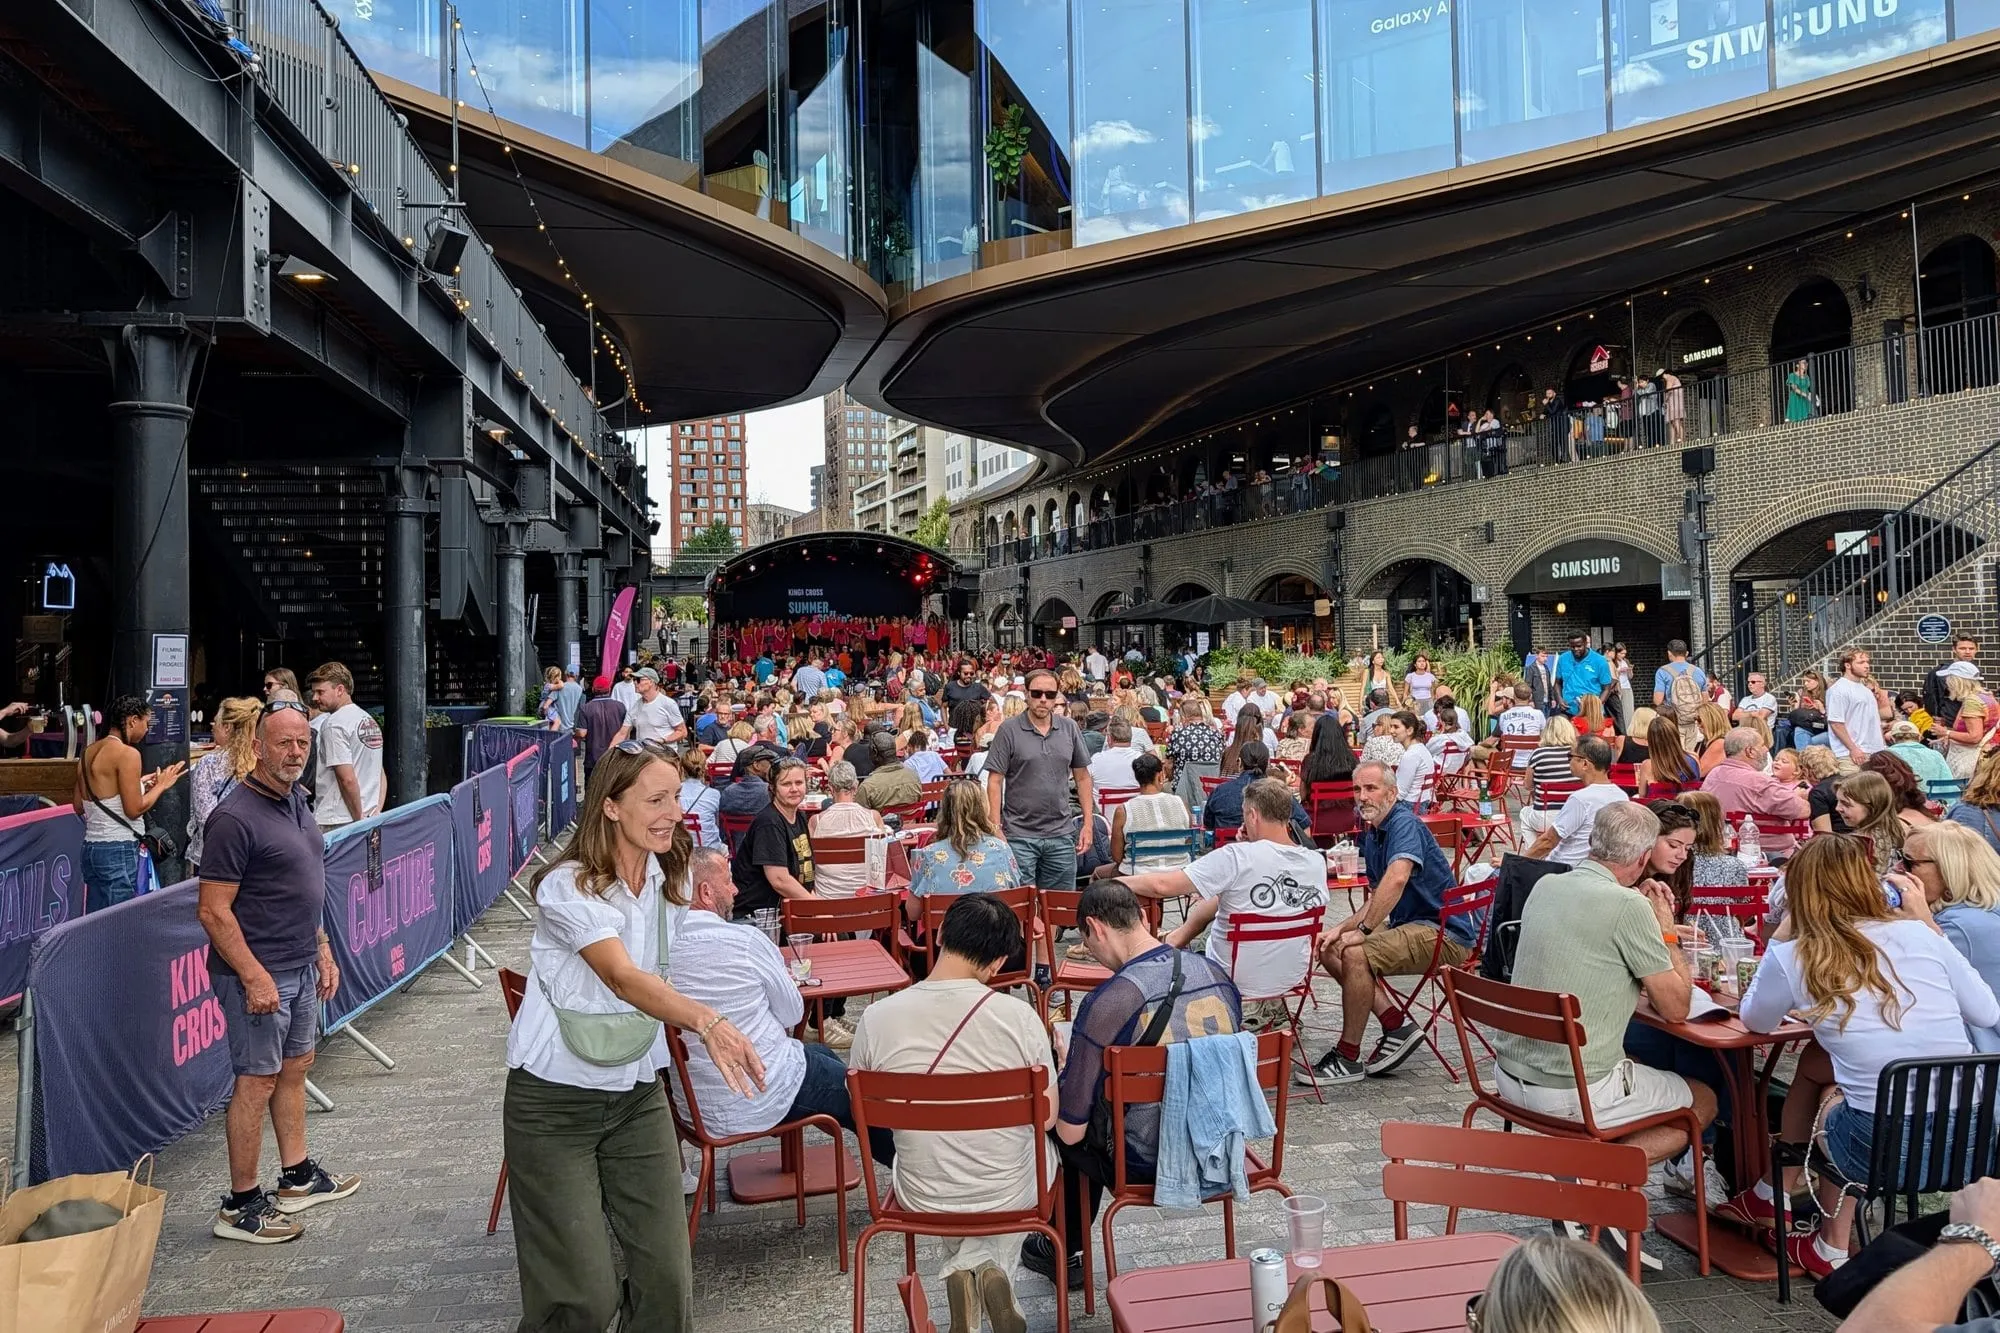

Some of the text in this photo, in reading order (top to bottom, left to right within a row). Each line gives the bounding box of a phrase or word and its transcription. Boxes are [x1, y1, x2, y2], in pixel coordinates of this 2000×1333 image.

[1371, 7, 1432, 33] Galaxy
[1687, 0, 1898, 70] SAMSUNG
[1684, 346, 1724, 363] SAMSUNG
[1551, 557, 1620, 578] SAMSUNG
[805, 588, 823, 596] CROSS
[788, 601, 829, 614] SUMMER
[0, 854, 71, 945] AILS
[348, 842, 436, 953] CULTURE
[172, 995, 228, 1067] CROS
